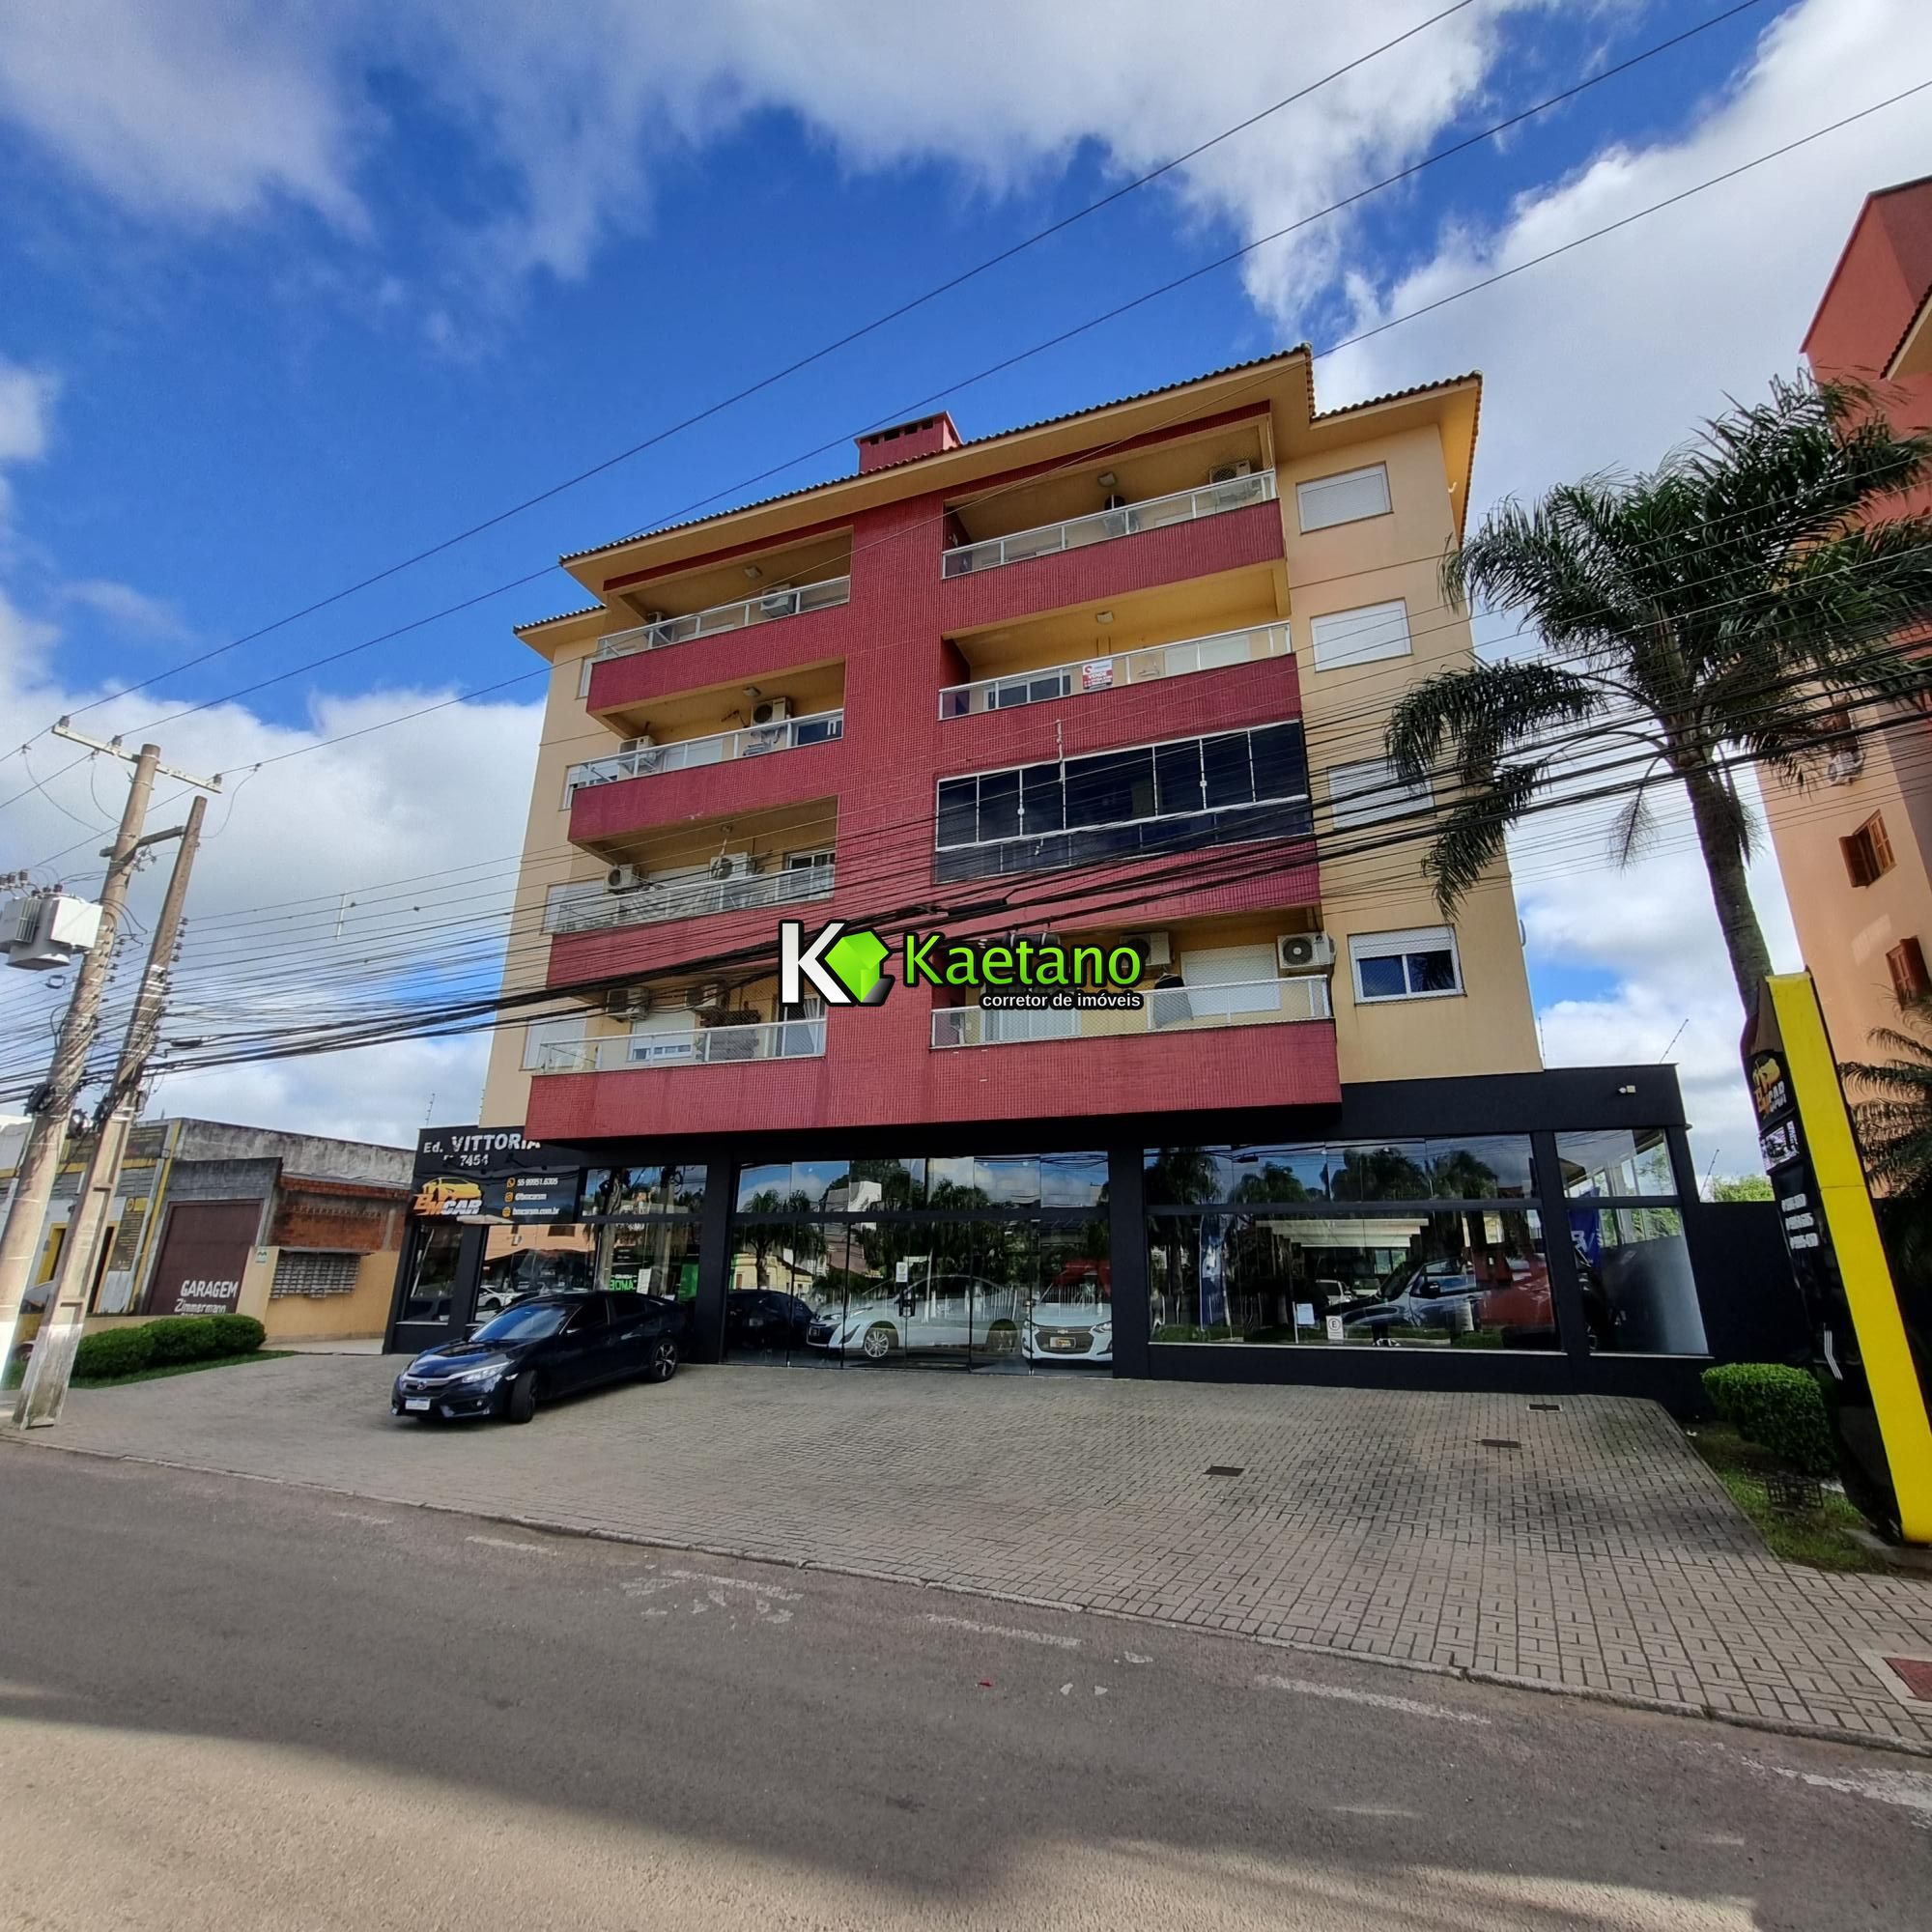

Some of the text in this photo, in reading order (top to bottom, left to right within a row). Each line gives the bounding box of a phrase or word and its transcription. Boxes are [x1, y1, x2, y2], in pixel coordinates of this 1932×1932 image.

[423, 1141, 443, 1153] Ed.
[180, 1280, 239, 1298] GARAGEM
[175, 1298, 227, 1313] Zimmermann
